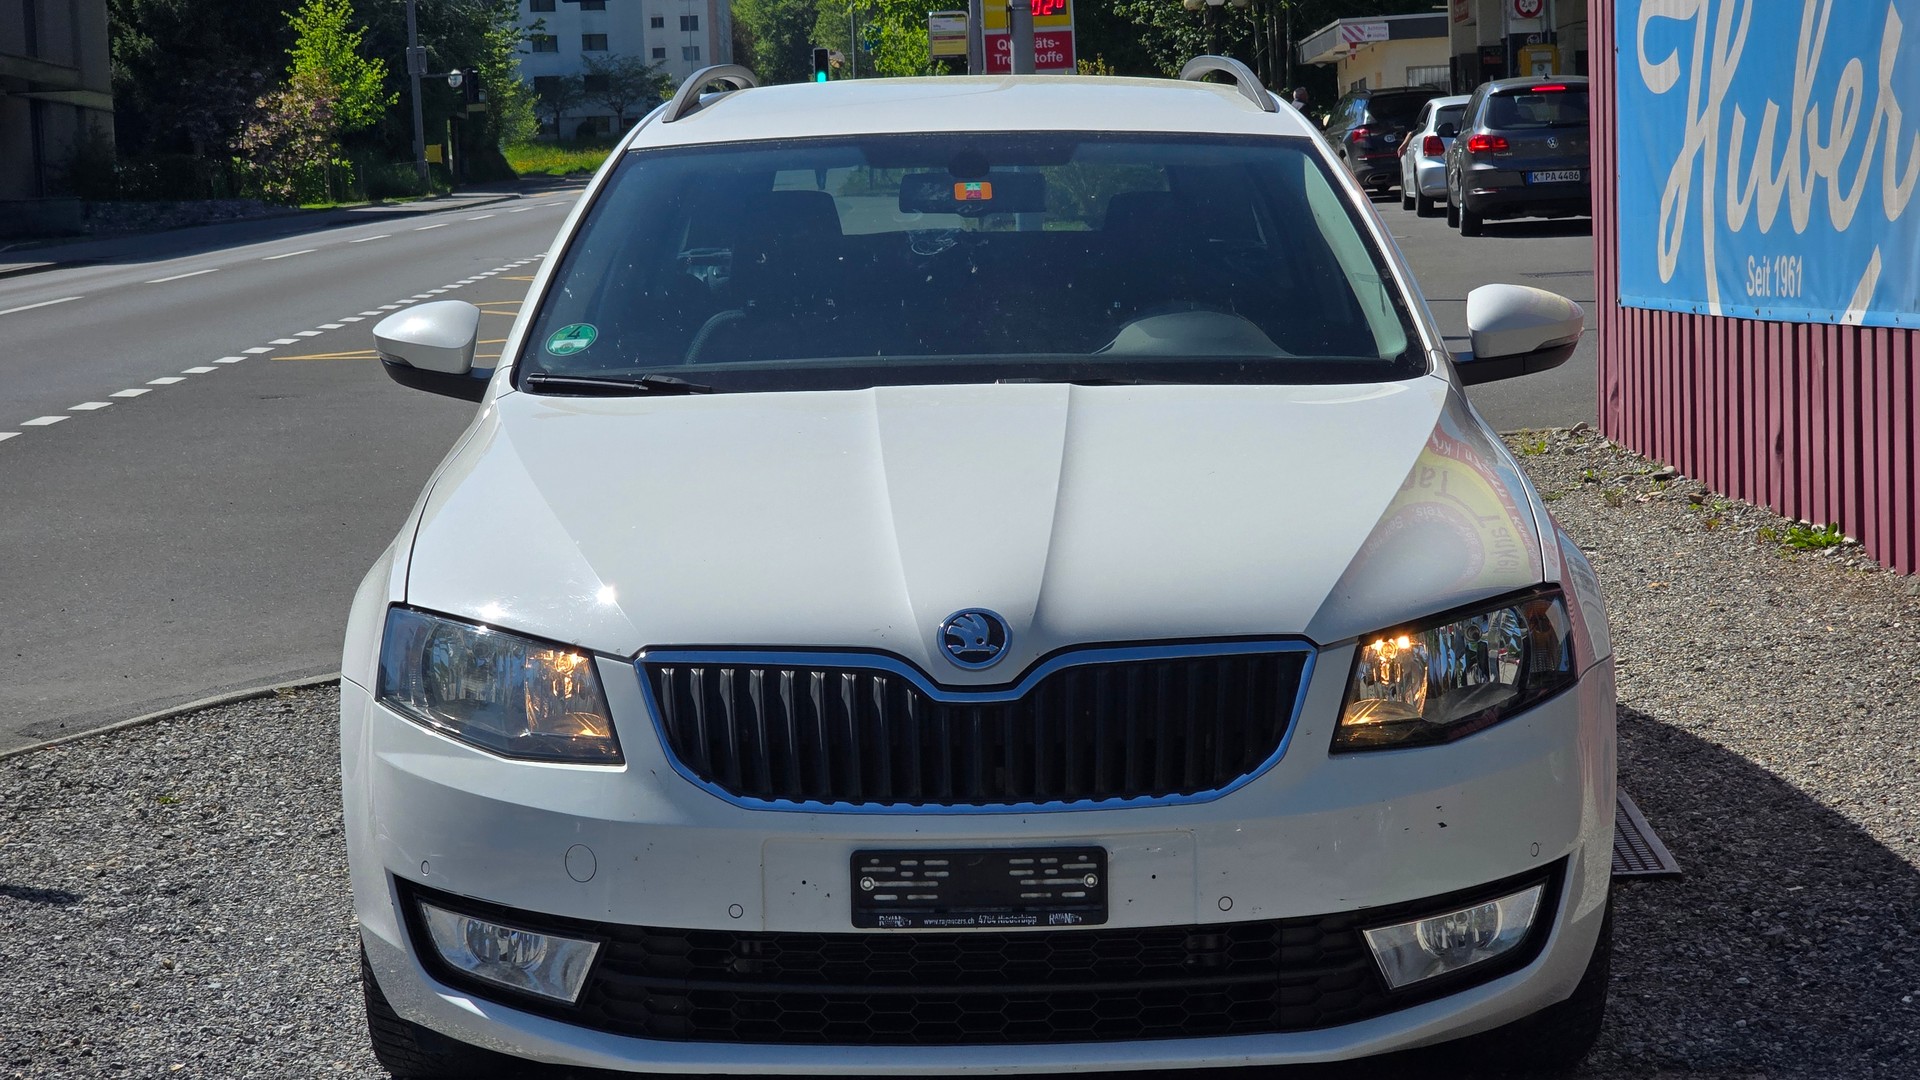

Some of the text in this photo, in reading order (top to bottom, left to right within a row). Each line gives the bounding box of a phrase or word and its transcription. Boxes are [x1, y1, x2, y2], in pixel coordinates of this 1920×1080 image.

[997, 37, 1060, 50] Qäts-
[994, 51, 1063, 65] Trtoffe
[1637, 0, 1920, 305] Huber
[1533, 171, 1579, 181] K PA 4486
[1746, 255, 1802, 298] Seit 1961
[567, 326, 581, 339] 4
